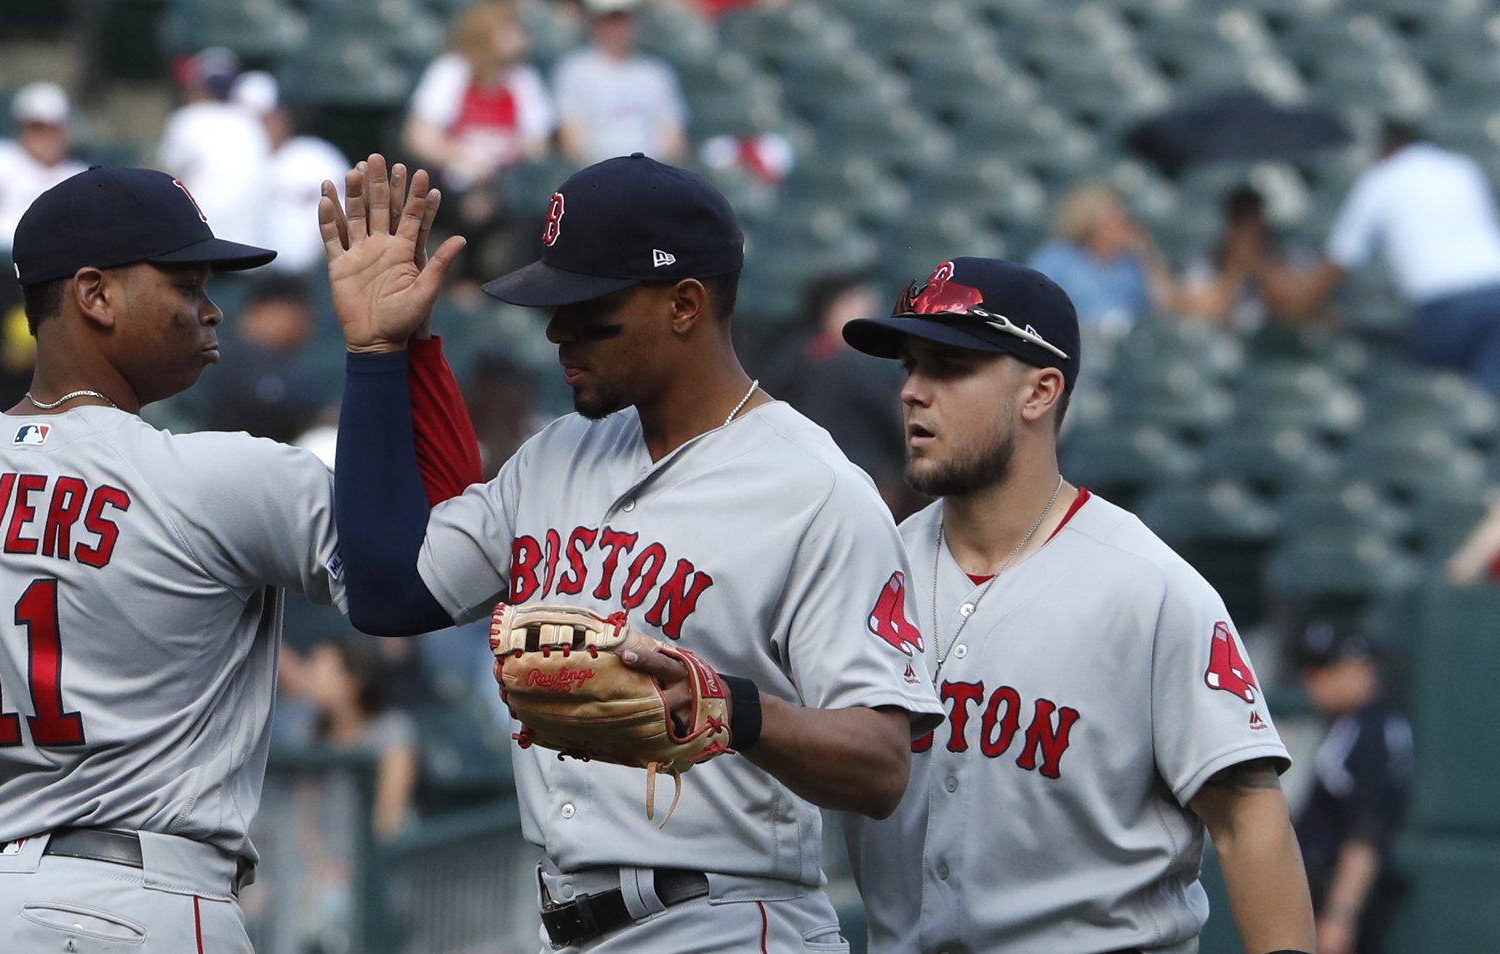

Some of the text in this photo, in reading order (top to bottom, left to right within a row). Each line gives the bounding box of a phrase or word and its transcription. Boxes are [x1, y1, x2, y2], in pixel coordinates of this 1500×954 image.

[542, 192, 565, 247] B
[330, 558, 343, 576] ML
[509, 526, 713, 640] BOSTON
[525, 665, 596, 689] Rawlings
[911, 679, 1081, 779] TON
